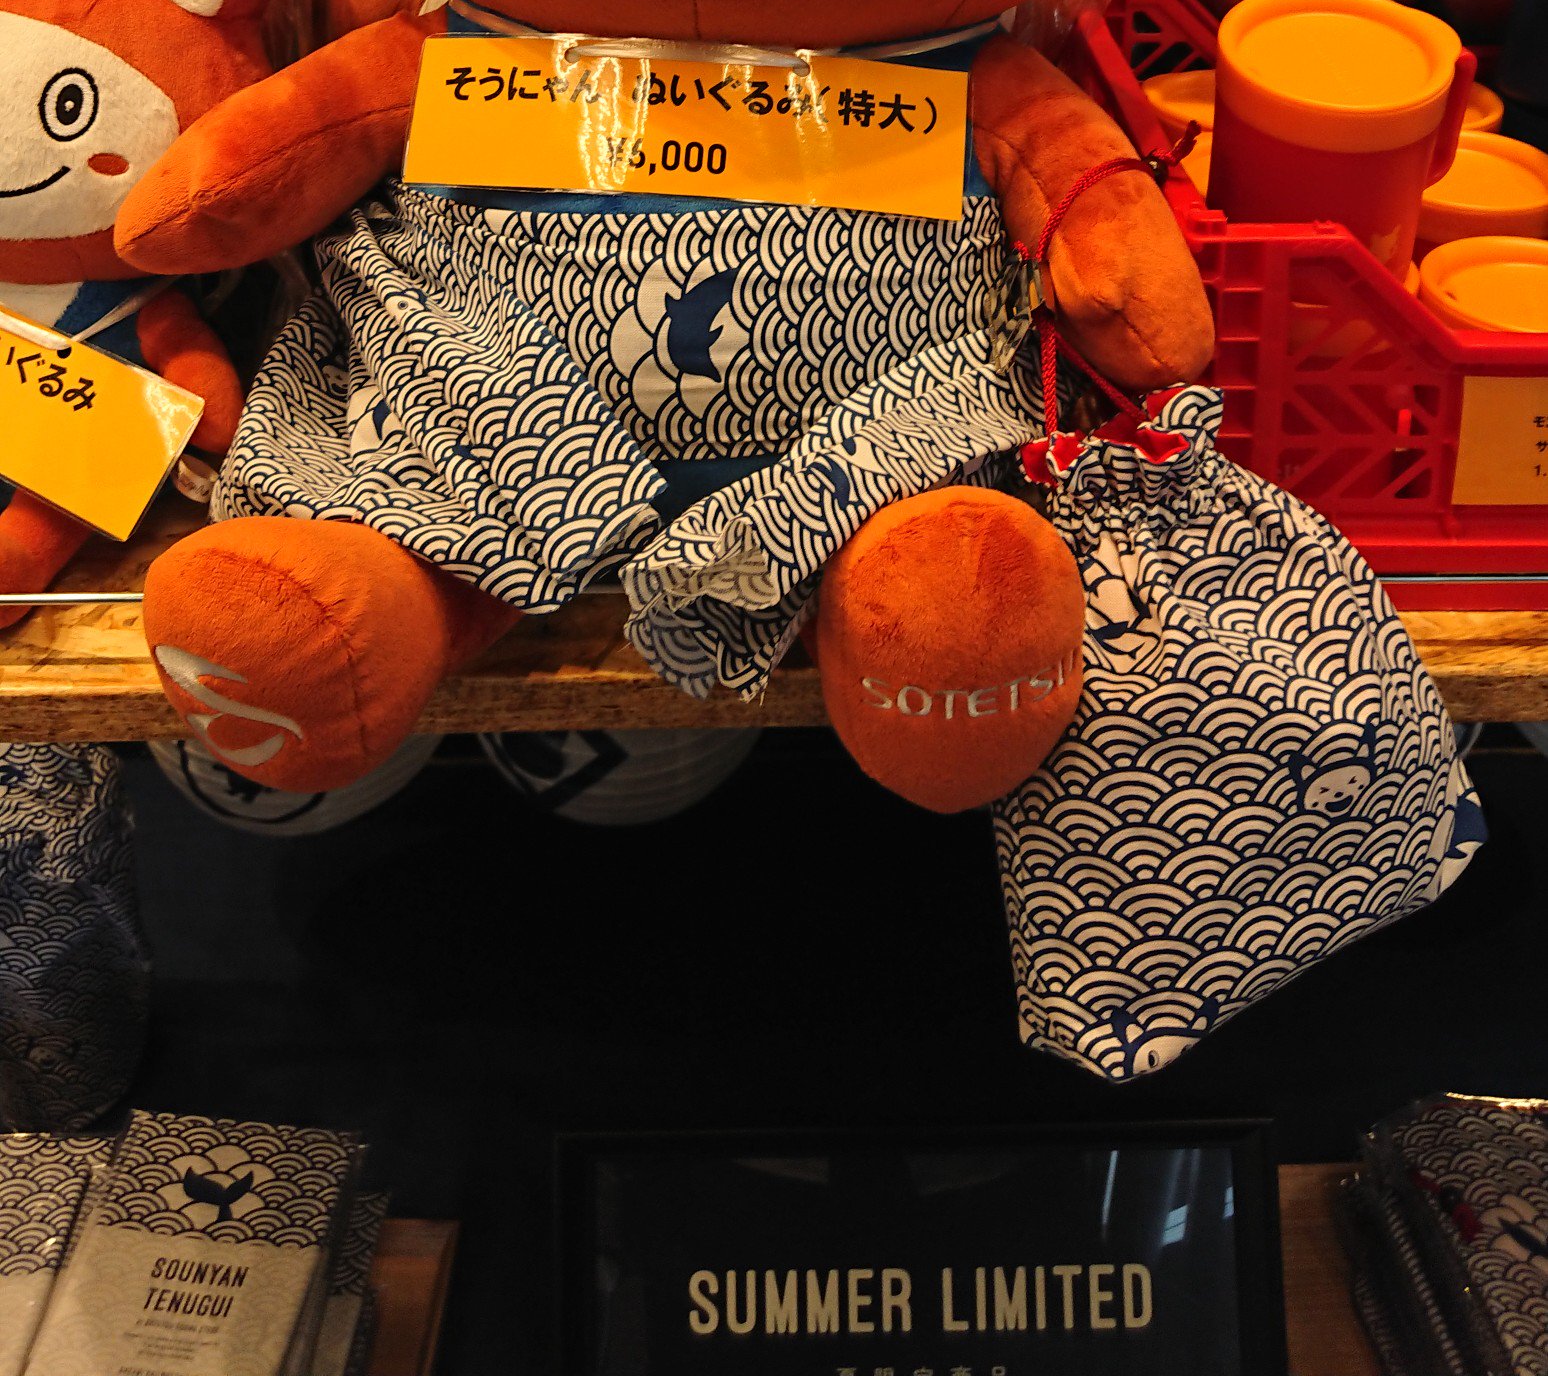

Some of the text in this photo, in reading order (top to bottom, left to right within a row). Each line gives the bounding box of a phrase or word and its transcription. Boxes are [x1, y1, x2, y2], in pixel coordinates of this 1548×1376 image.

[445, 65, 603, 104] そうにゃん
[151, 1257, 249, 1288] SOUNYAN
[143, 1287, 234, 1318] TENUGUI
[688, 1262, 1153, 1335] SUMMER LIMITED
